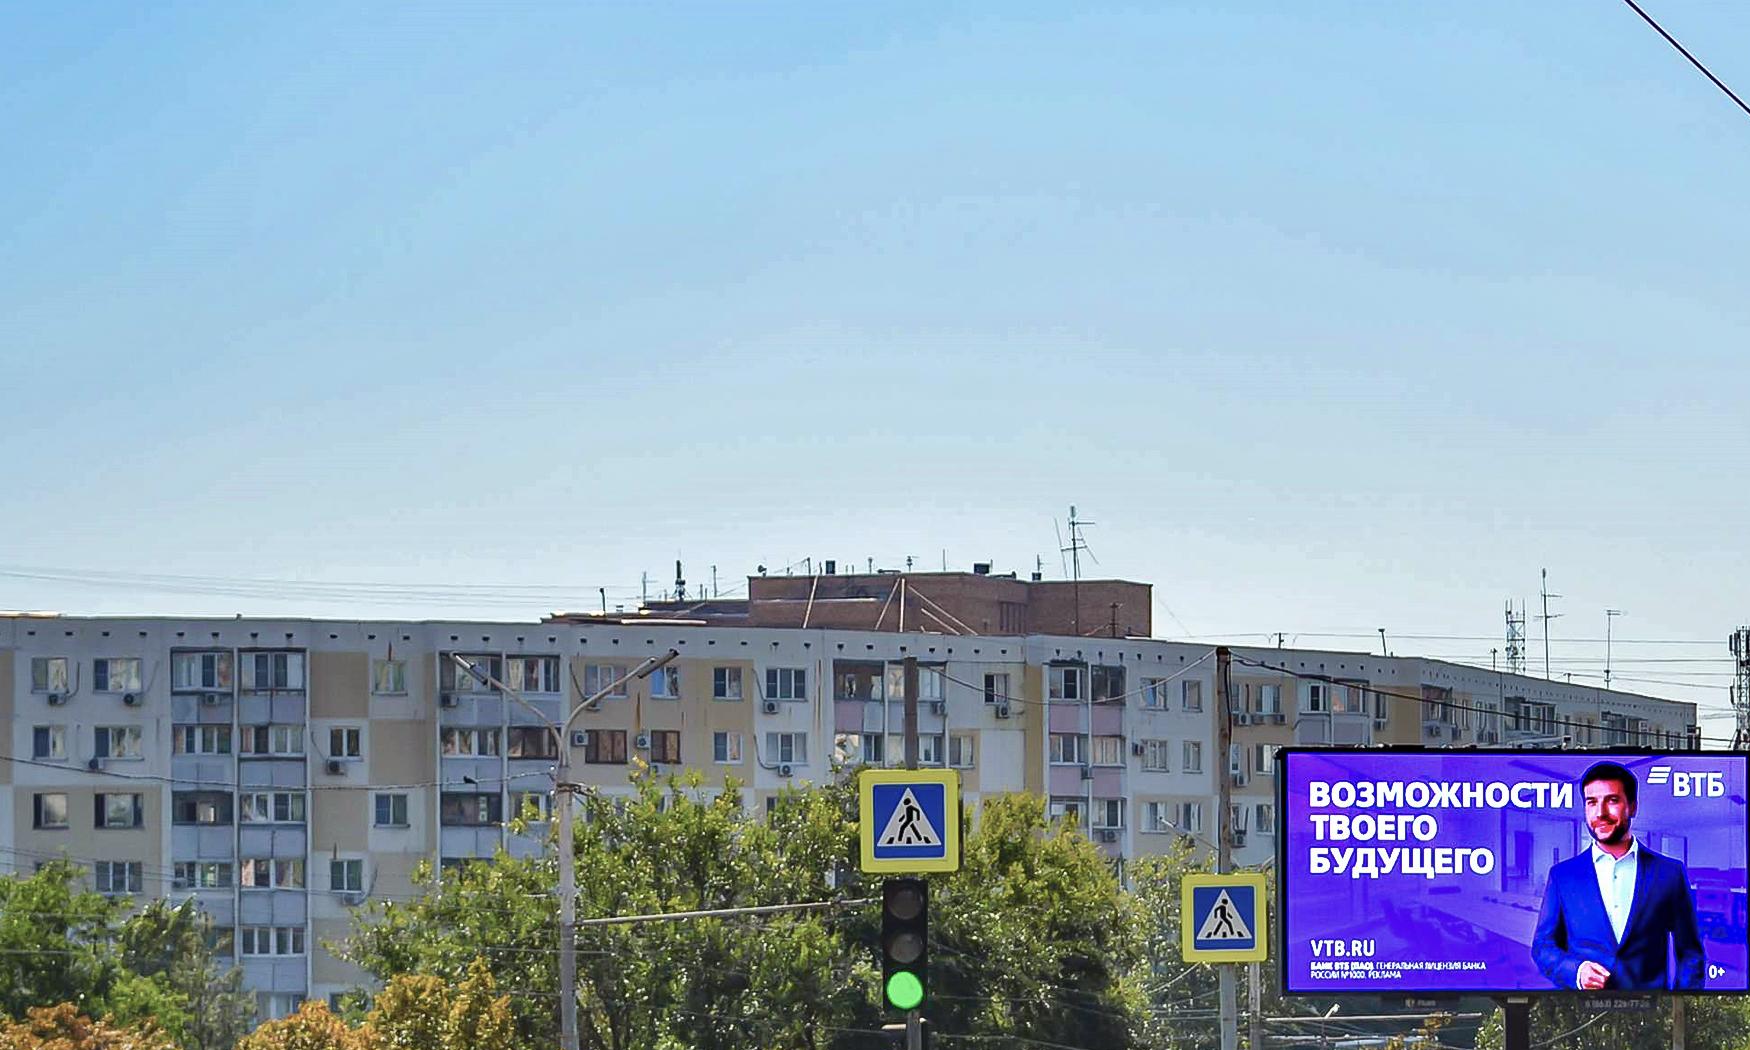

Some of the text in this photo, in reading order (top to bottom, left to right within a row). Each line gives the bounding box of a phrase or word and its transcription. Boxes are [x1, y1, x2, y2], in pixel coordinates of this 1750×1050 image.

[1309, 781, 1573, 808] ВОЗМОЖНОСТИ
[1672, 772, 1725, 798] ВТБ
[1309, 814, 1438, 841] ТВОЕГО
[1309, 847, 1495, 879] БУДУЩЕГО
[1310, 939, 1375, 957] VTB.RU
[1462, 961, 1486, 970] БАНКА
[1708, 965, 1726, 979] 0+
